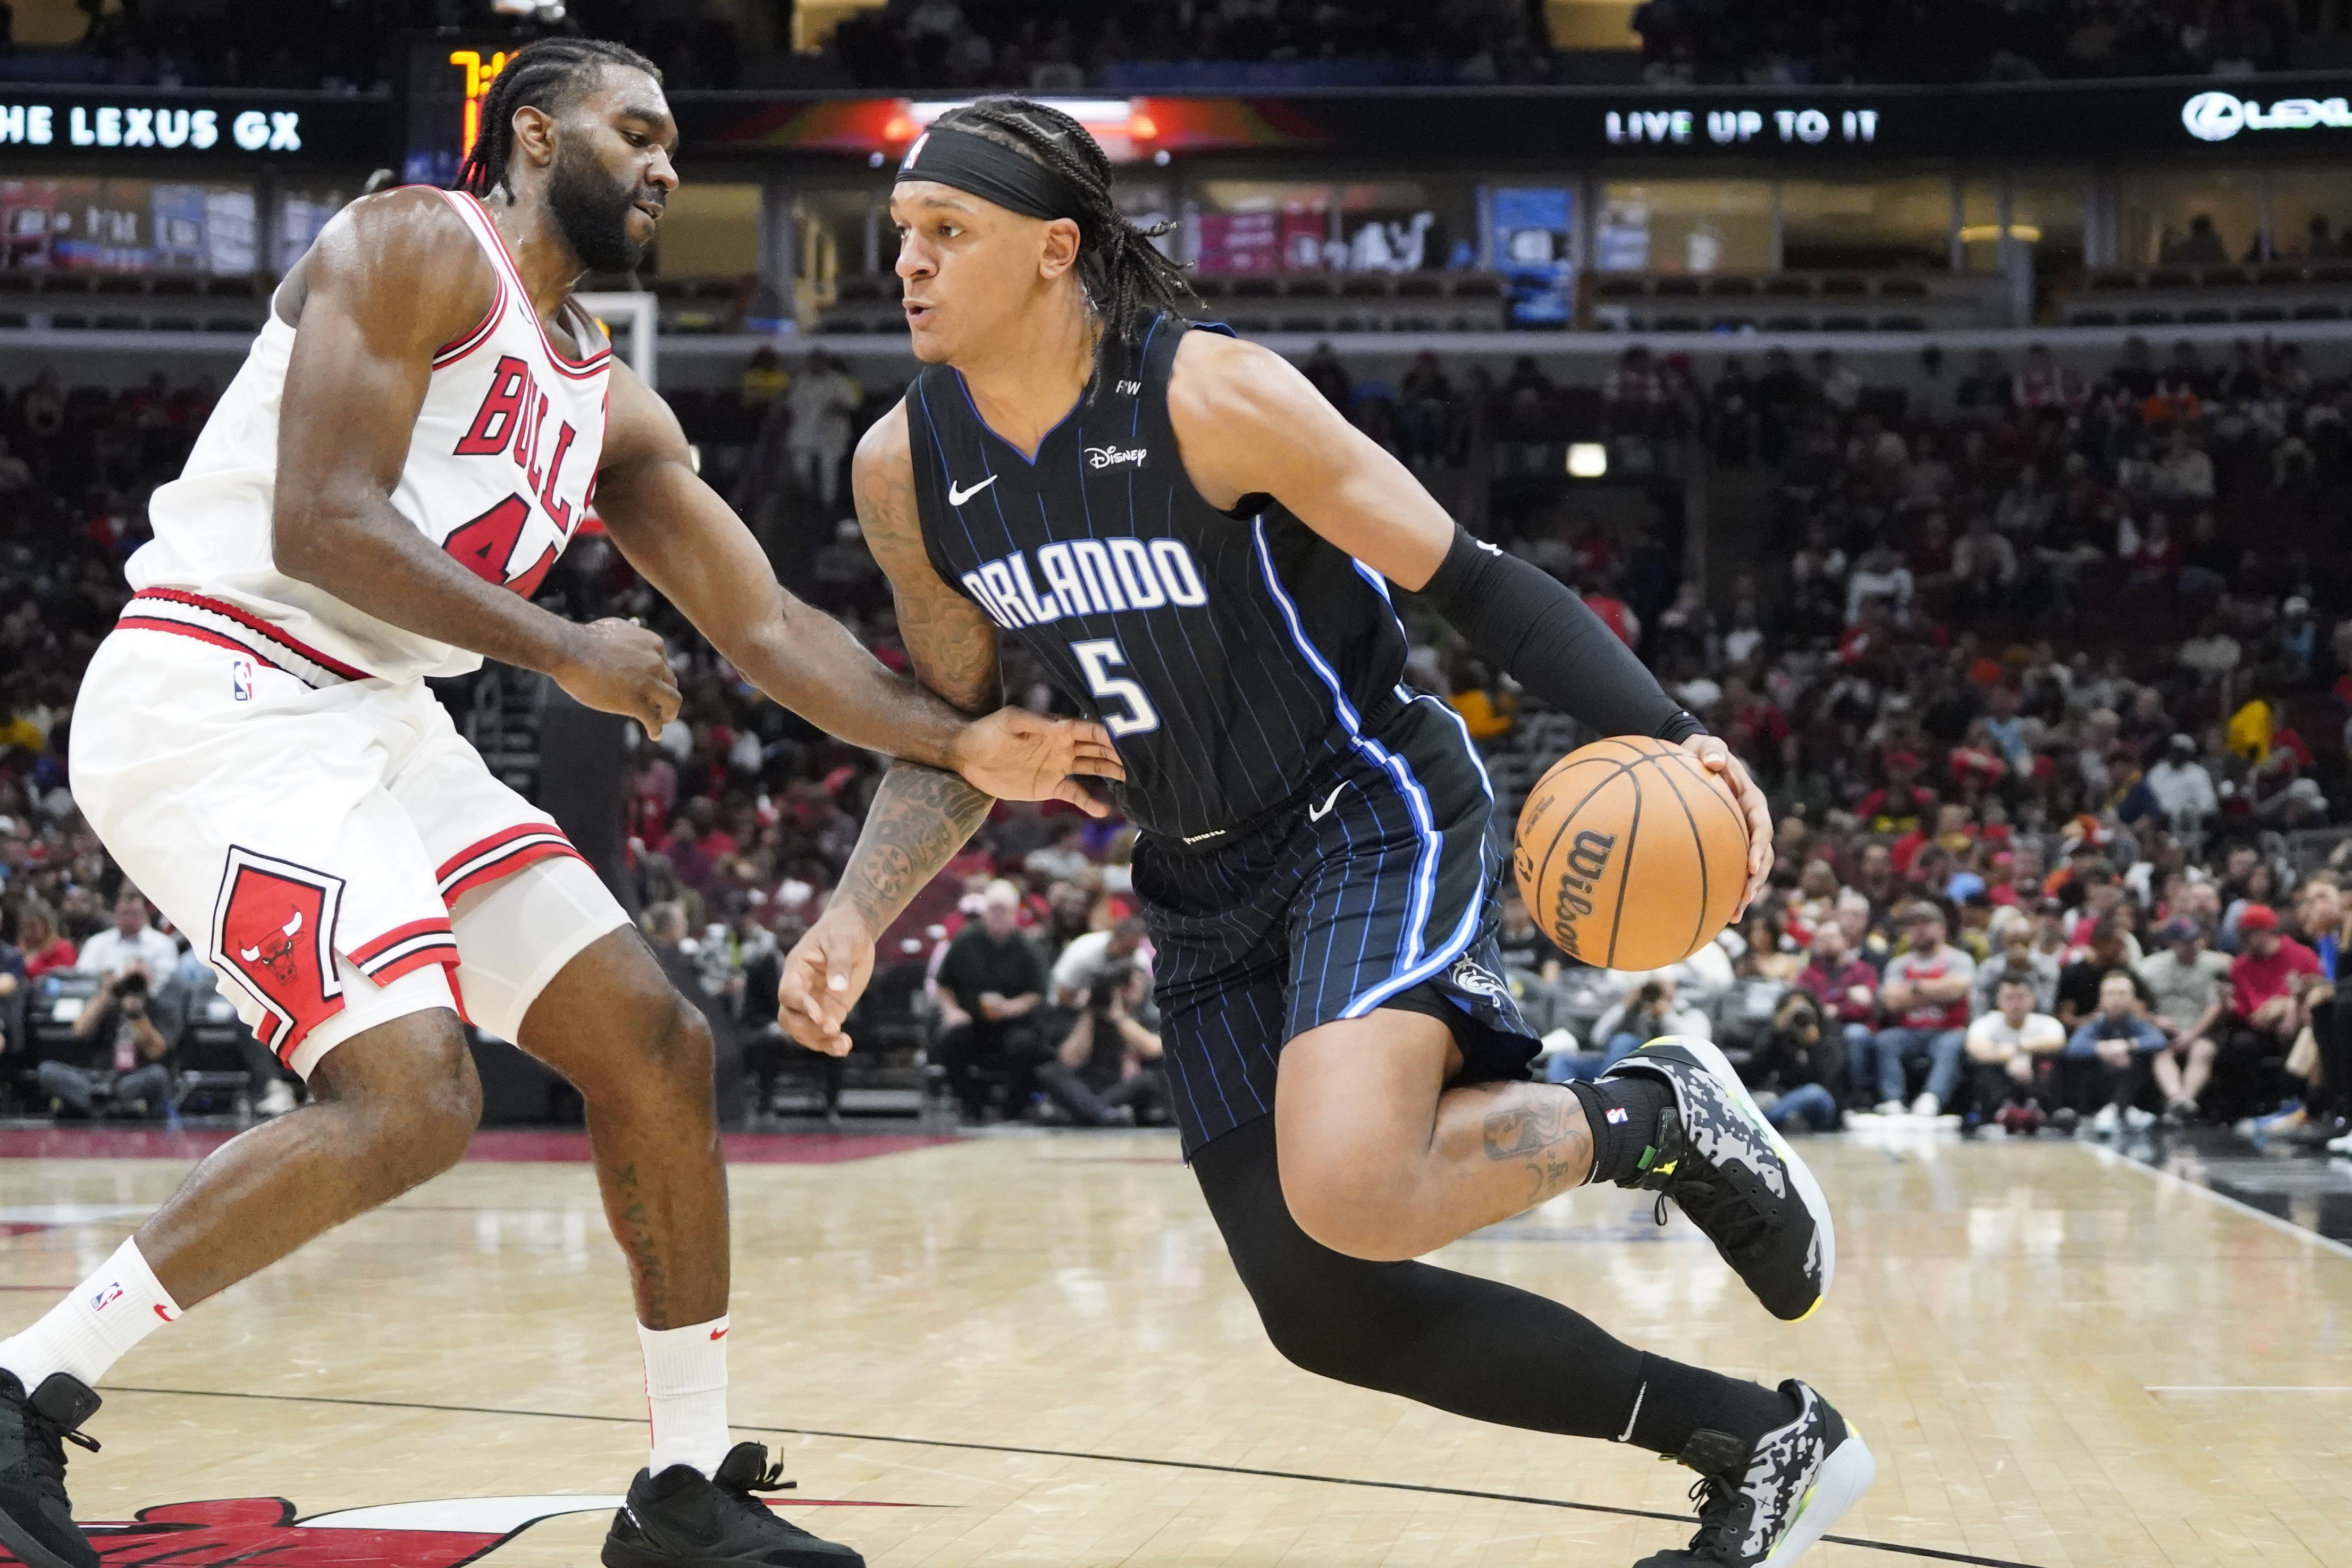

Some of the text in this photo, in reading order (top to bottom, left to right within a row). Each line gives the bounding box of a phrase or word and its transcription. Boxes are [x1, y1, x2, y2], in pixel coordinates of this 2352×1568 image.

[70, 107, 219, 149] LEXUS
[233, 111, 302, 151] GX
[1605, 109, 1879, 145] LIVE UP TO IT
[452, 354, 583, 536] BULL
[1083, 445, 1147, 469] Disney
[960, 536, 1209, 630] ORLANDO
[1069, 637, 1161, 738] 5
[1553, 828, 1618, 958] Wilson
